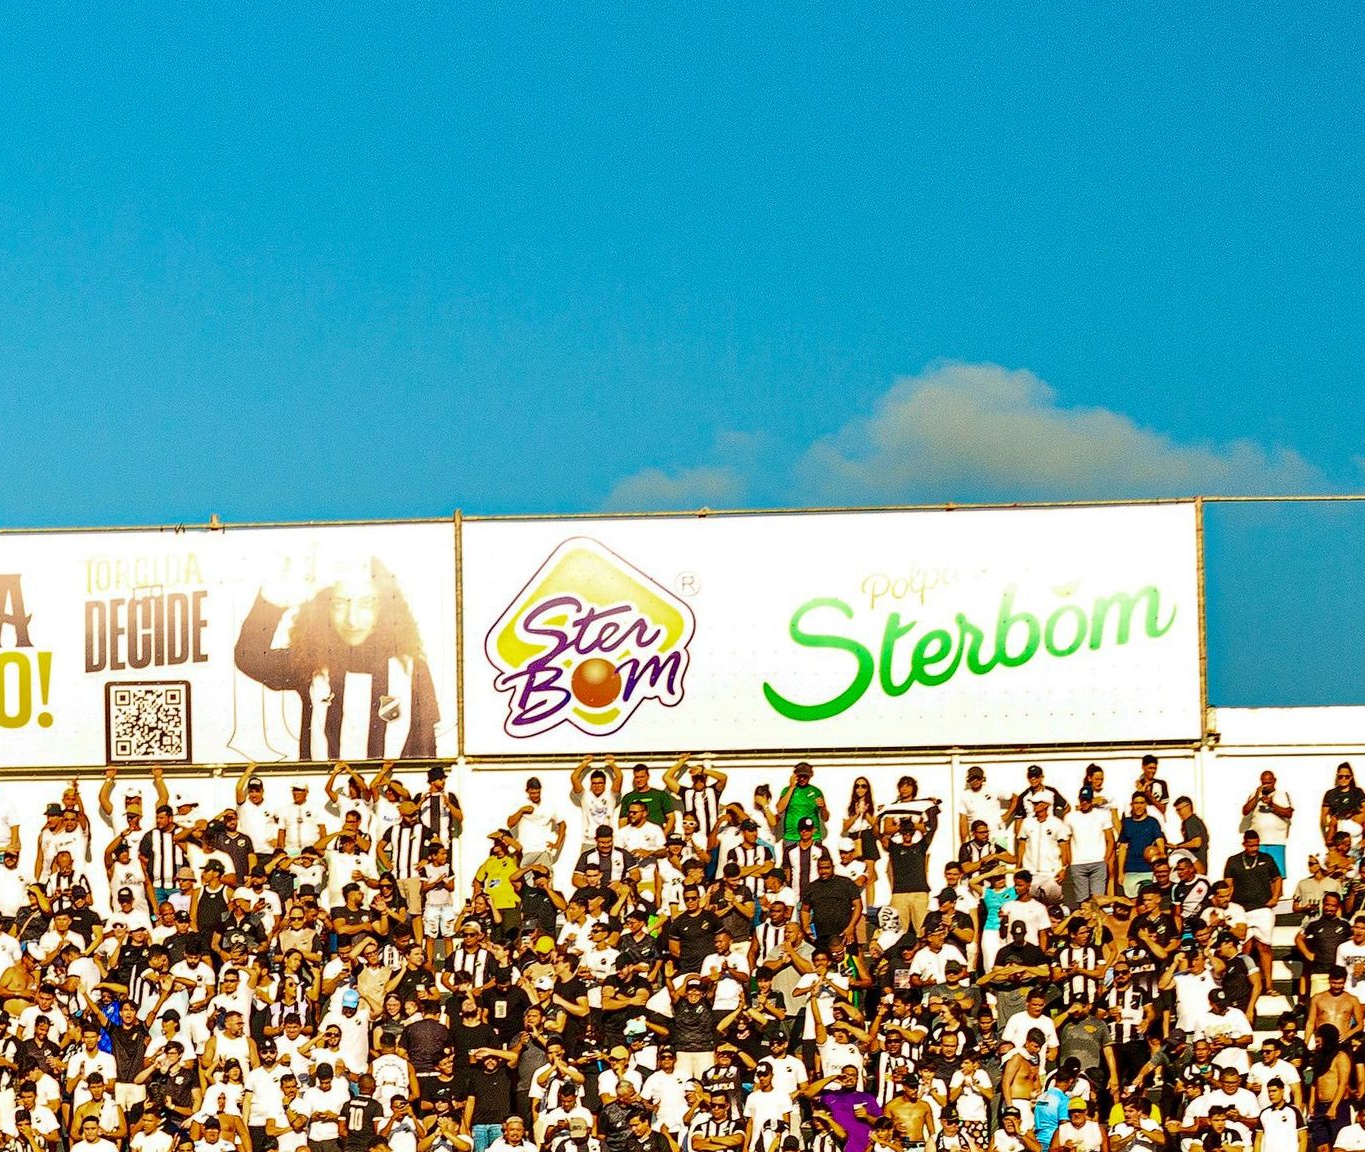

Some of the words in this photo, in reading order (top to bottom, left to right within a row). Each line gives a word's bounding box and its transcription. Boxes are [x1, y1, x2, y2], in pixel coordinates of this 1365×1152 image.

[84, 590, 209, 674] DECIDE
[523, 597, 661, 657] Ster
[349, 1107, 364, 1131] 10
